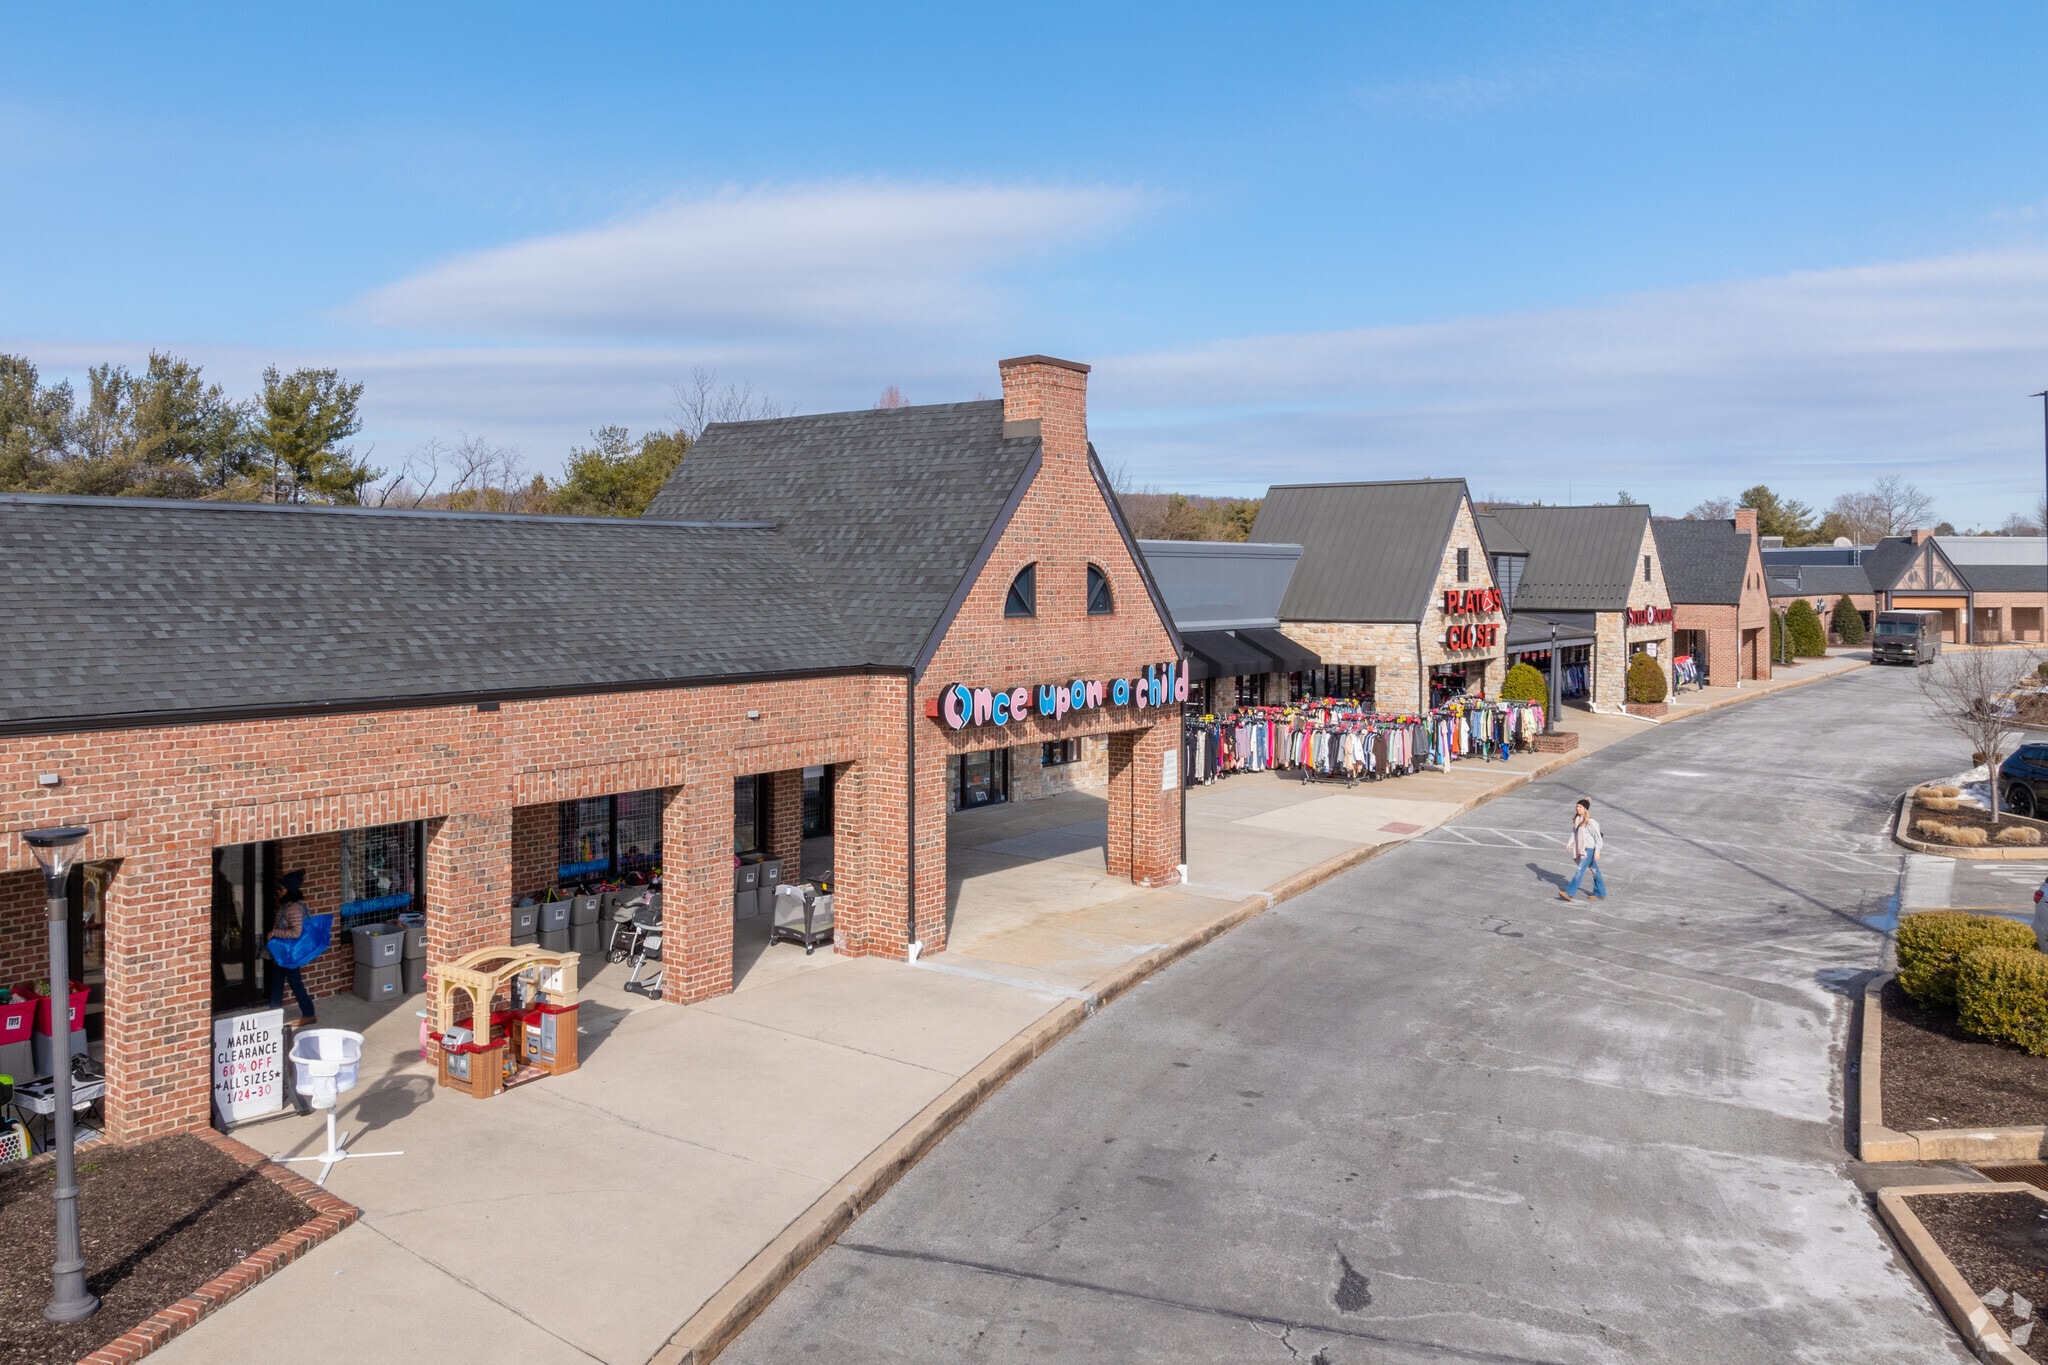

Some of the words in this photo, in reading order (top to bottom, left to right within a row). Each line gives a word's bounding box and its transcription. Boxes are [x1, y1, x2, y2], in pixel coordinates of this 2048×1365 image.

[1447, 588, 1501, 615] PLATO'S
[1449, 624, 1500, 651] CLOSET
[943, 682, 1028, 730] Once
[1039, 679, 1103, 721] upon
[1112, 678, 1130, 706] a
[1135, 659, 1189, 709] child
[239, 1019, 257, 1032] ALL
[227, 1031, 269, 1049] MARKED
[218, 1042, 277, 1064] CLEARANCE
[250, 1056, 272, 1071] OFF
[227, 1084, 272, 1104] 1/24-30
